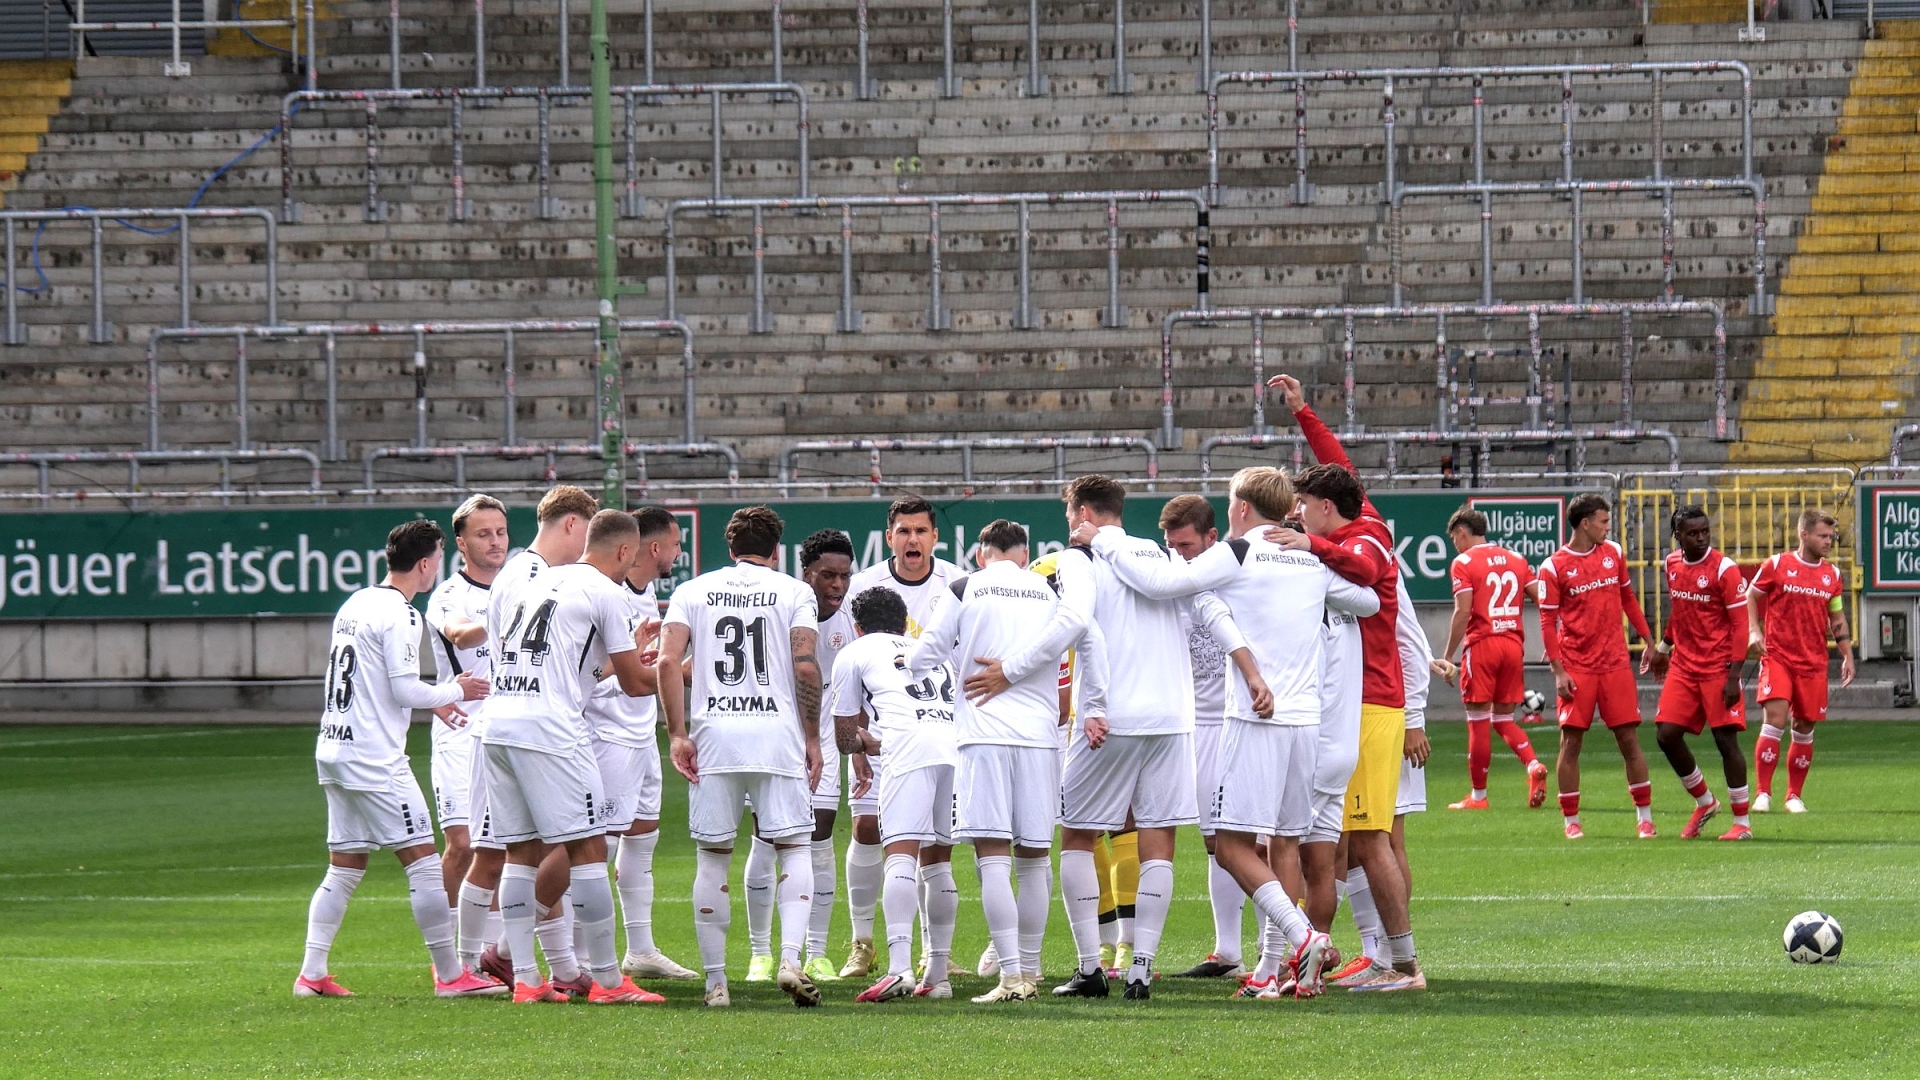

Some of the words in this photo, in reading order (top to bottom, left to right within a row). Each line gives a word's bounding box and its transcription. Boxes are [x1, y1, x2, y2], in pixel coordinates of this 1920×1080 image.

[0, 538, 137, 612] äuer
[974, 586, 988, 598] KSV
[990, 586, 1019, 598] HESSEN
[1021, 589, 1050, 601] KASSEL
[1486, 570, 1520, 617] 22
[714, 615, 770, 686] 31
[327, 644, 357, 713] 13
[707, 695, 779, 712] POLYMA
[1355, 794, 1360, 809] 1
